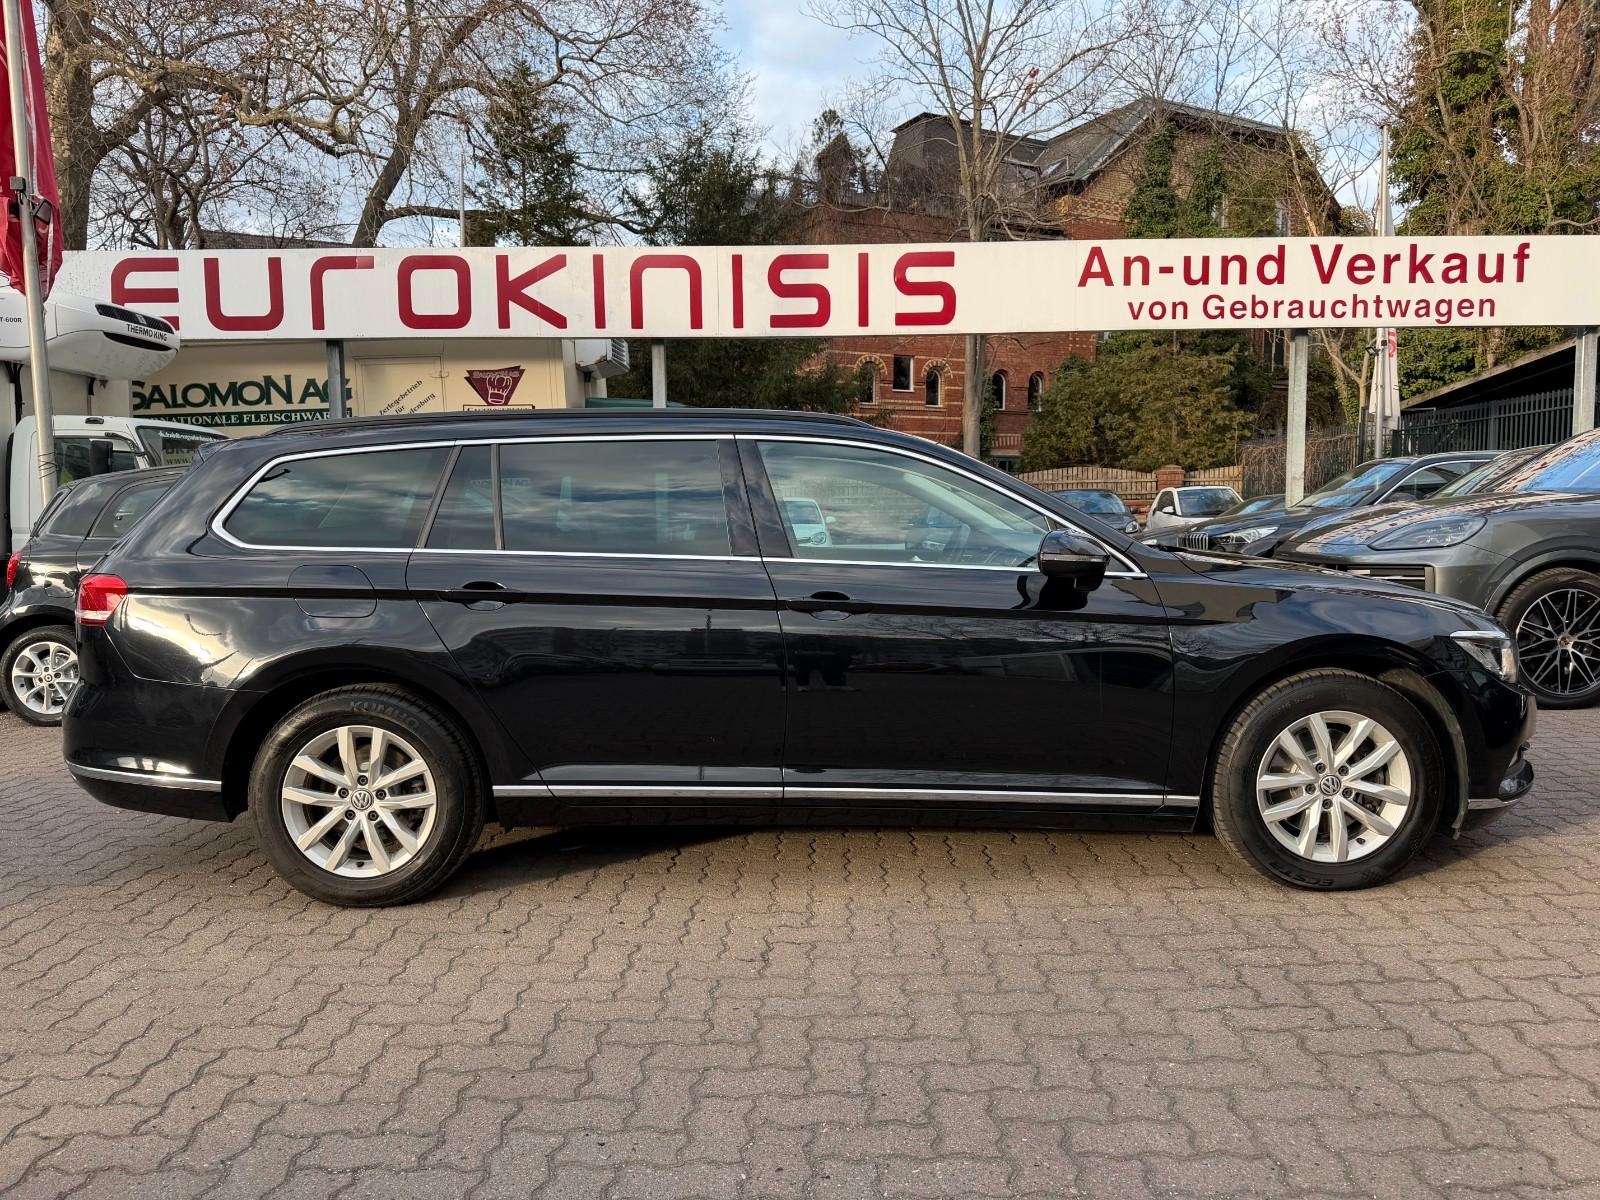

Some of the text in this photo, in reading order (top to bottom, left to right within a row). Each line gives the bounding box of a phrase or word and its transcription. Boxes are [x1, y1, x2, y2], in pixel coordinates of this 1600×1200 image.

[1077, 242, 1531, 287] An-und Verkauf
[1127, 293, 1496, 325] von Gebrauchtwagen
[126, 323, 168, 342] THERMO KING
[131, 374, 294, 411] SALOMON
